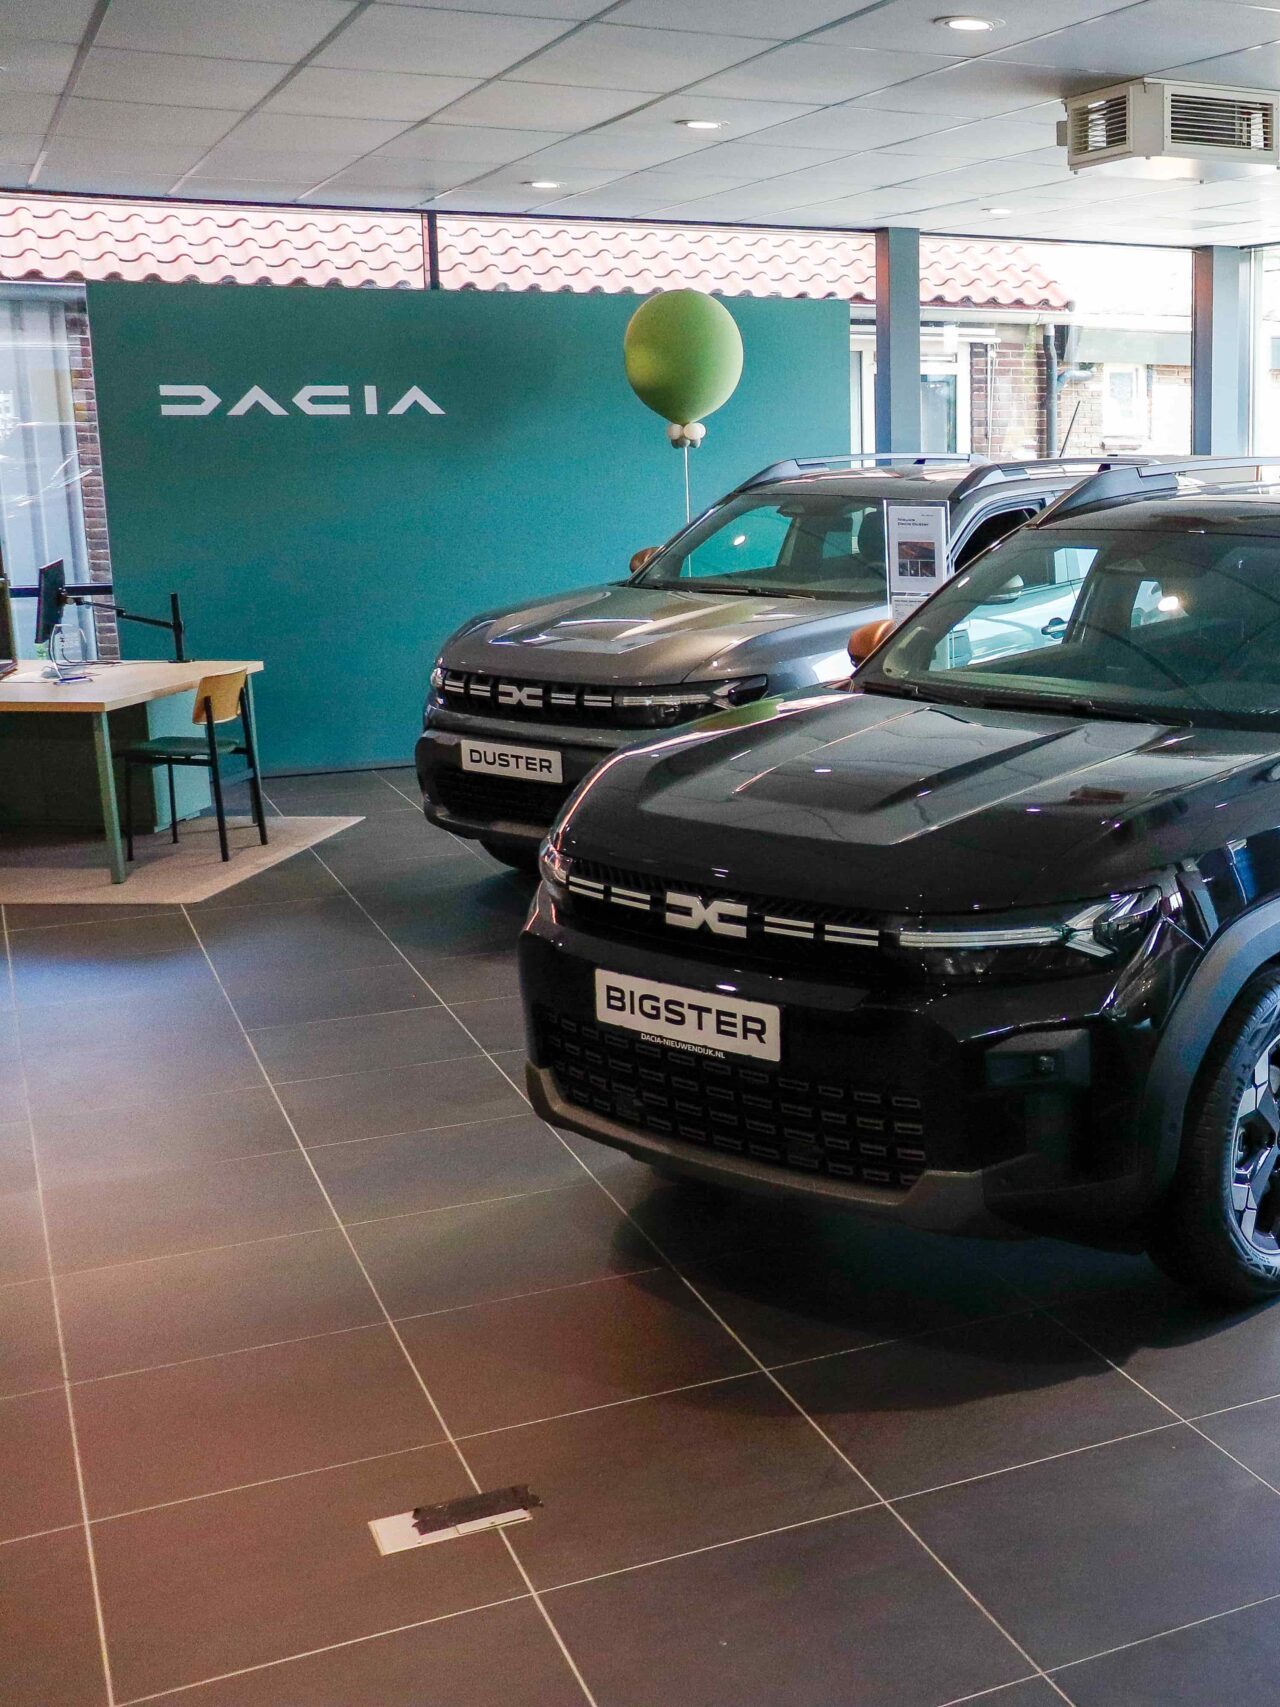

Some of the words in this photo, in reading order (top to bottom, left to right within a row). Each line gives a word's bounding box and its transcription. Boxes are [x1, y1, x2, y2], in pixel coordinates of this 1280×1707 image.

[159, 385, 446, 416] DACIA
[469, 748, 553, 774] DUSTER
[605, 984, 767, 1045] BIGSTER
[640, 1032, 726, 1059] DACIA-NIEUWENDIJK.NL
